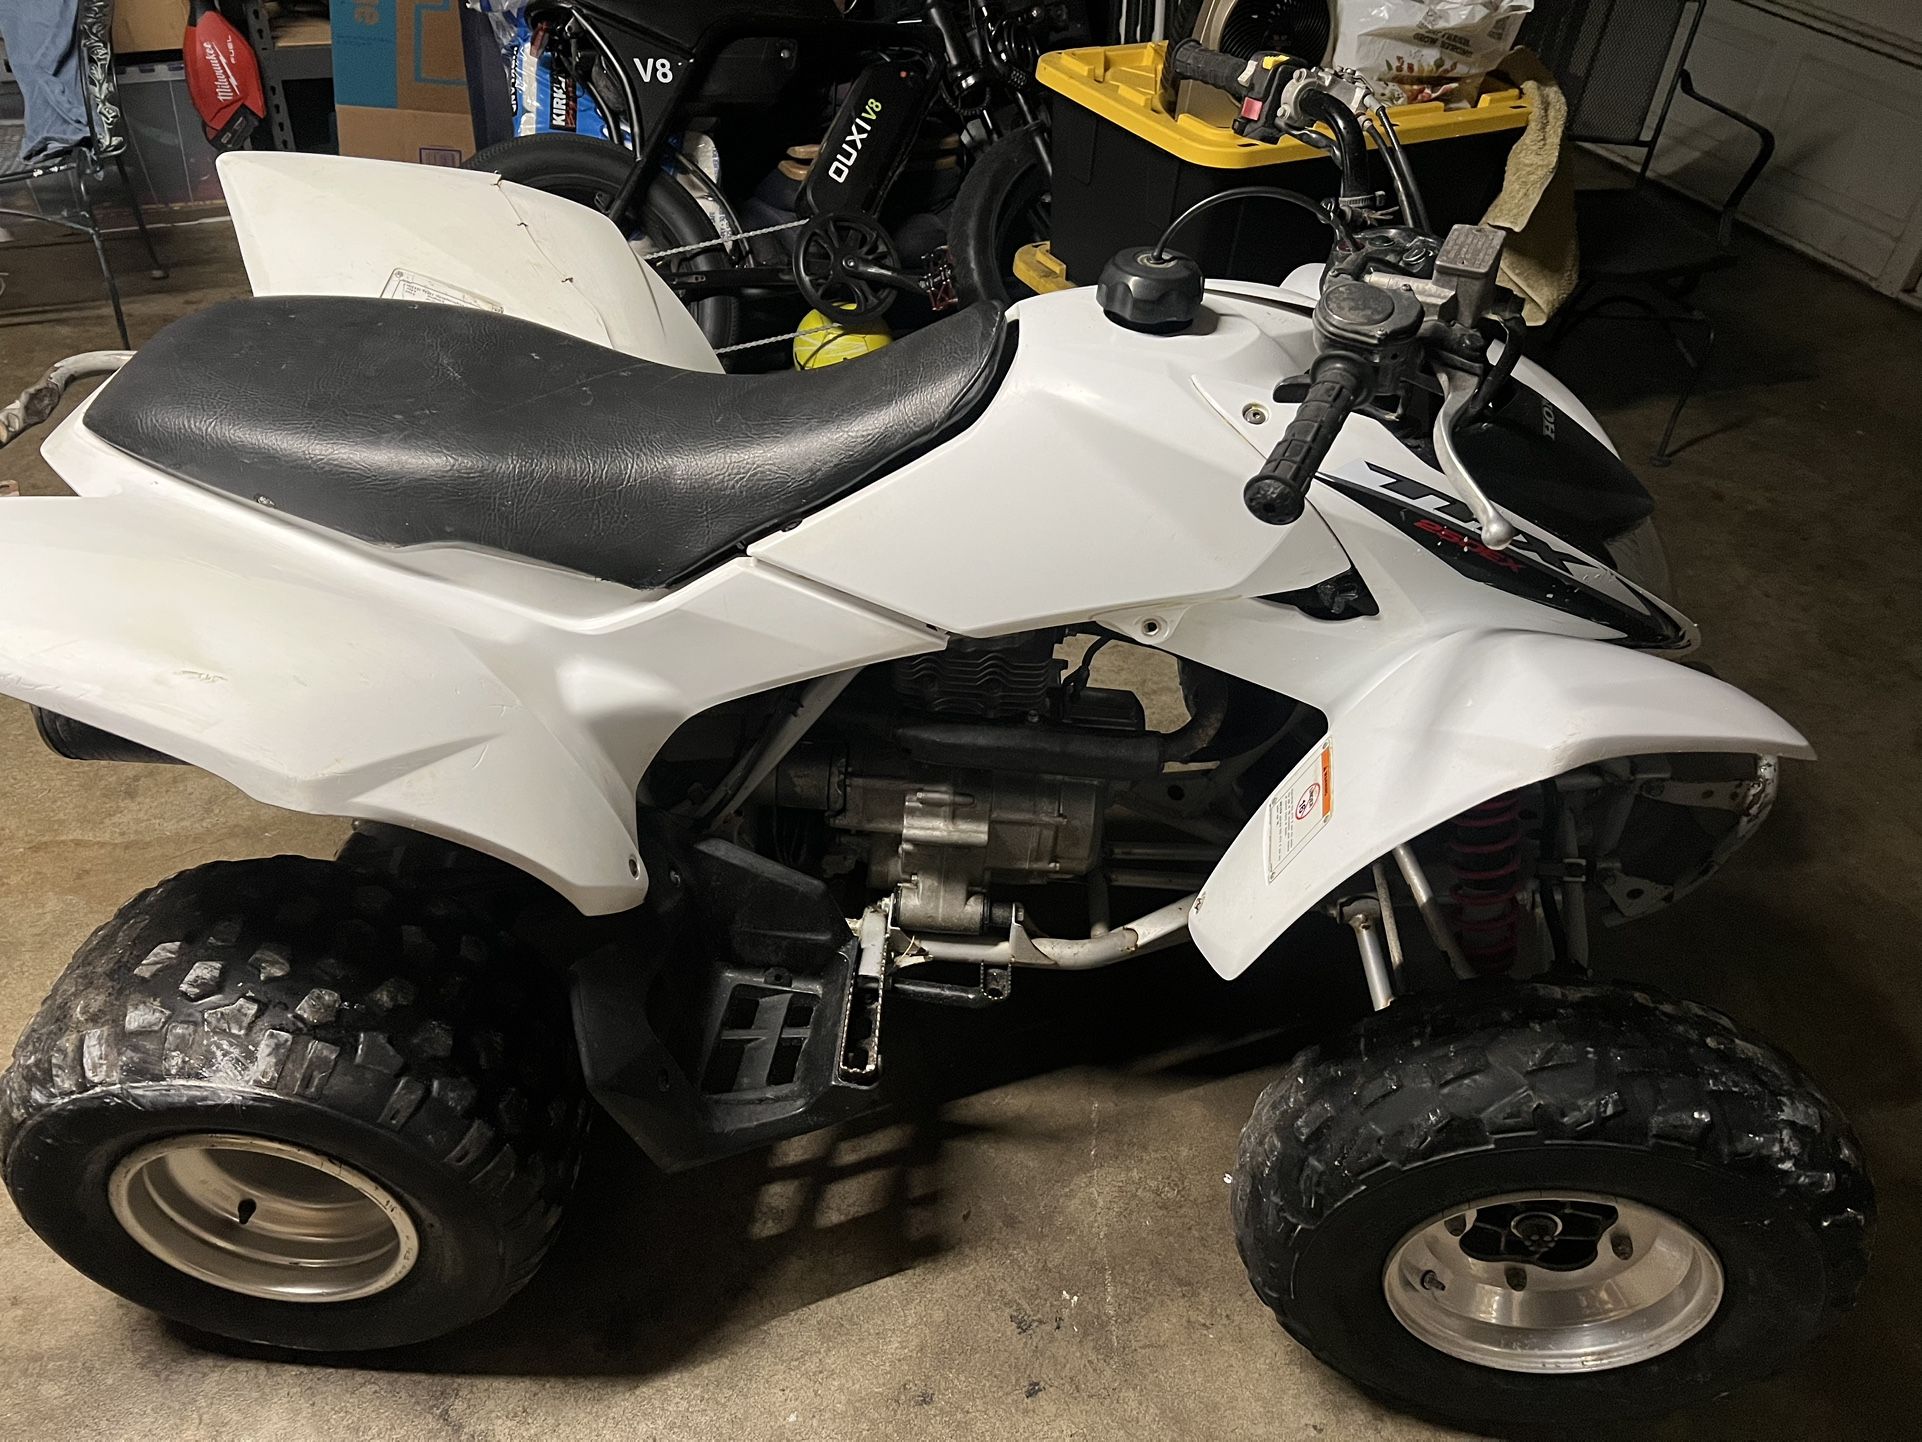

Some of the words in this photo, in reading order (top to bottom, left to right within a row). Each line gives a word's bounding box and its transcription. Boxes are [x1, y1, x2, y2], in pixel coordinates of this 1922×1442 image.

[203, 41, 234, 103] Milwaukee
[226, 34, 236, 64] FUEL
[633, 57, 673, 84] V8
[551, 76, 567, 127] KIRK
[828, 117, 872, 184] OUXI
[860, 98, 882, 120] V8
